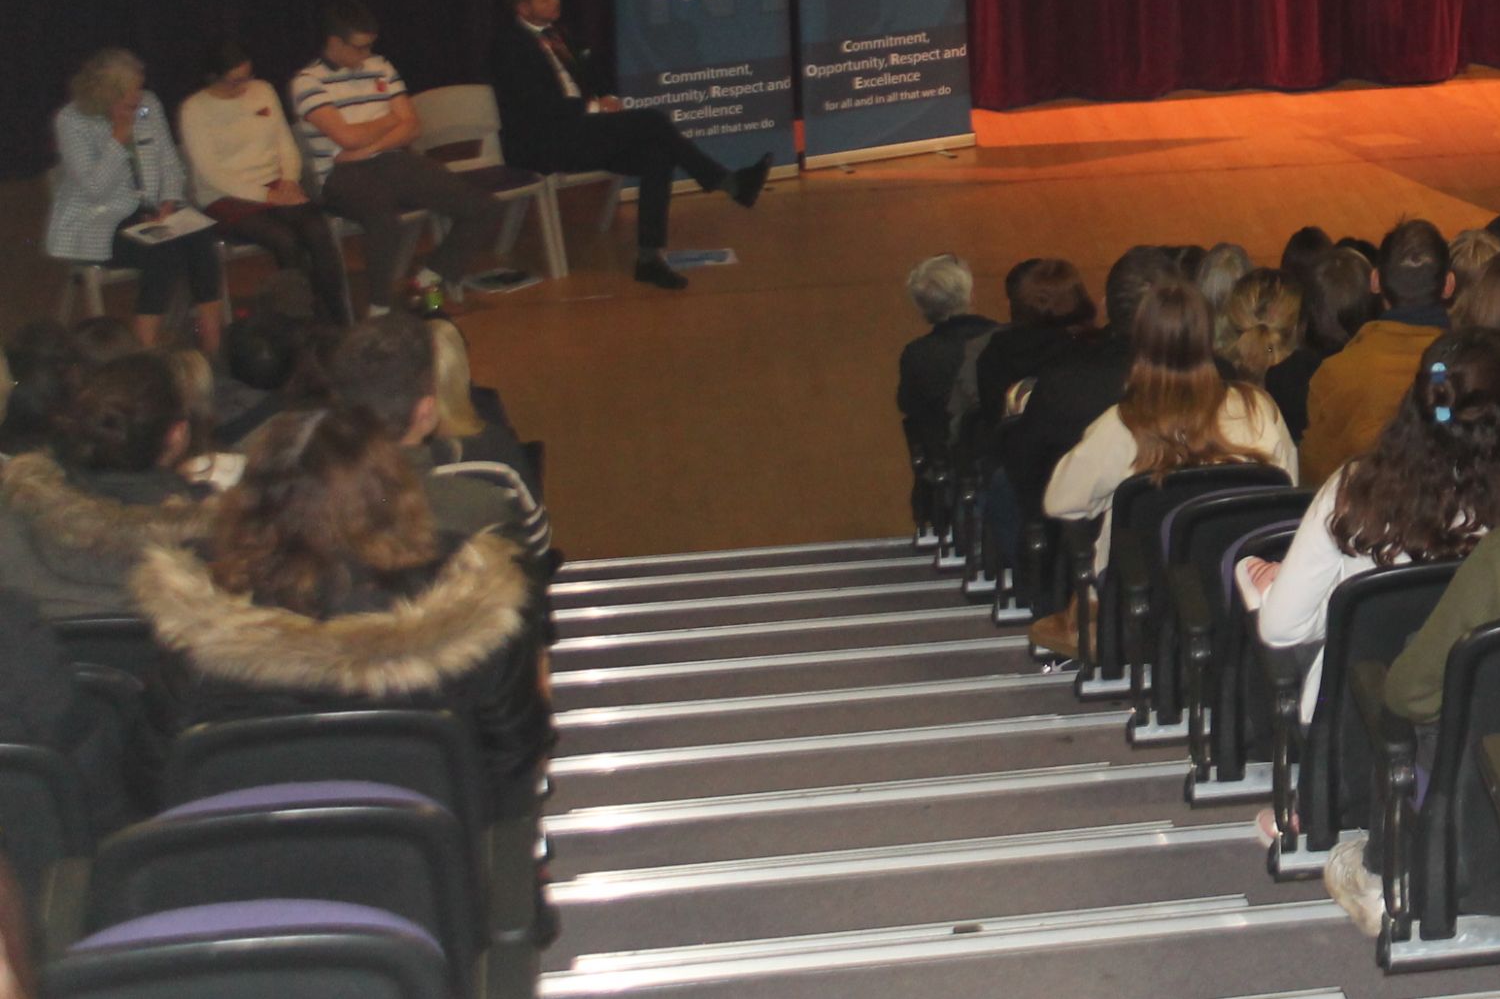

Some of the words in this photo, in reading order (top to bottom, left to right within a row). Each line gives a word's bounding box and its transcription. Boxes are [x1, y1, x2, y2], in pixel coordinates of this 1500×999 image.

[842, 31, 930, 53] Commitment,
[806, 57, 888, 78] Opportunity,
[890, 50, 940, 68] Respect
[943, 45, 967, 59] and
[661, 63, 753, 85] Commitment,
[854, 71, 921, 90] Excellence
[623, 87, 709, 109] Opportunity,
[711, 81, 764, 100] Respect
[767, 76, 791, 91] and
[825, 100, 839, 111] for
[841, 98, 852, 109] all
[855, 95, 873, 107] and
[876, 94, 885, 104] in
[887, 92, 898, 103] all
[900, 89, 920, 101] that
[922, 88, 936, 97] we
[938, 85, 951, 96] do
[672, 103, 744, 122] Excellence
[707, 124, 719, 135] all
[721, 122, 741, 133] that
[744, 122, 759, 130] we
[761, 118, 775, 129] do
